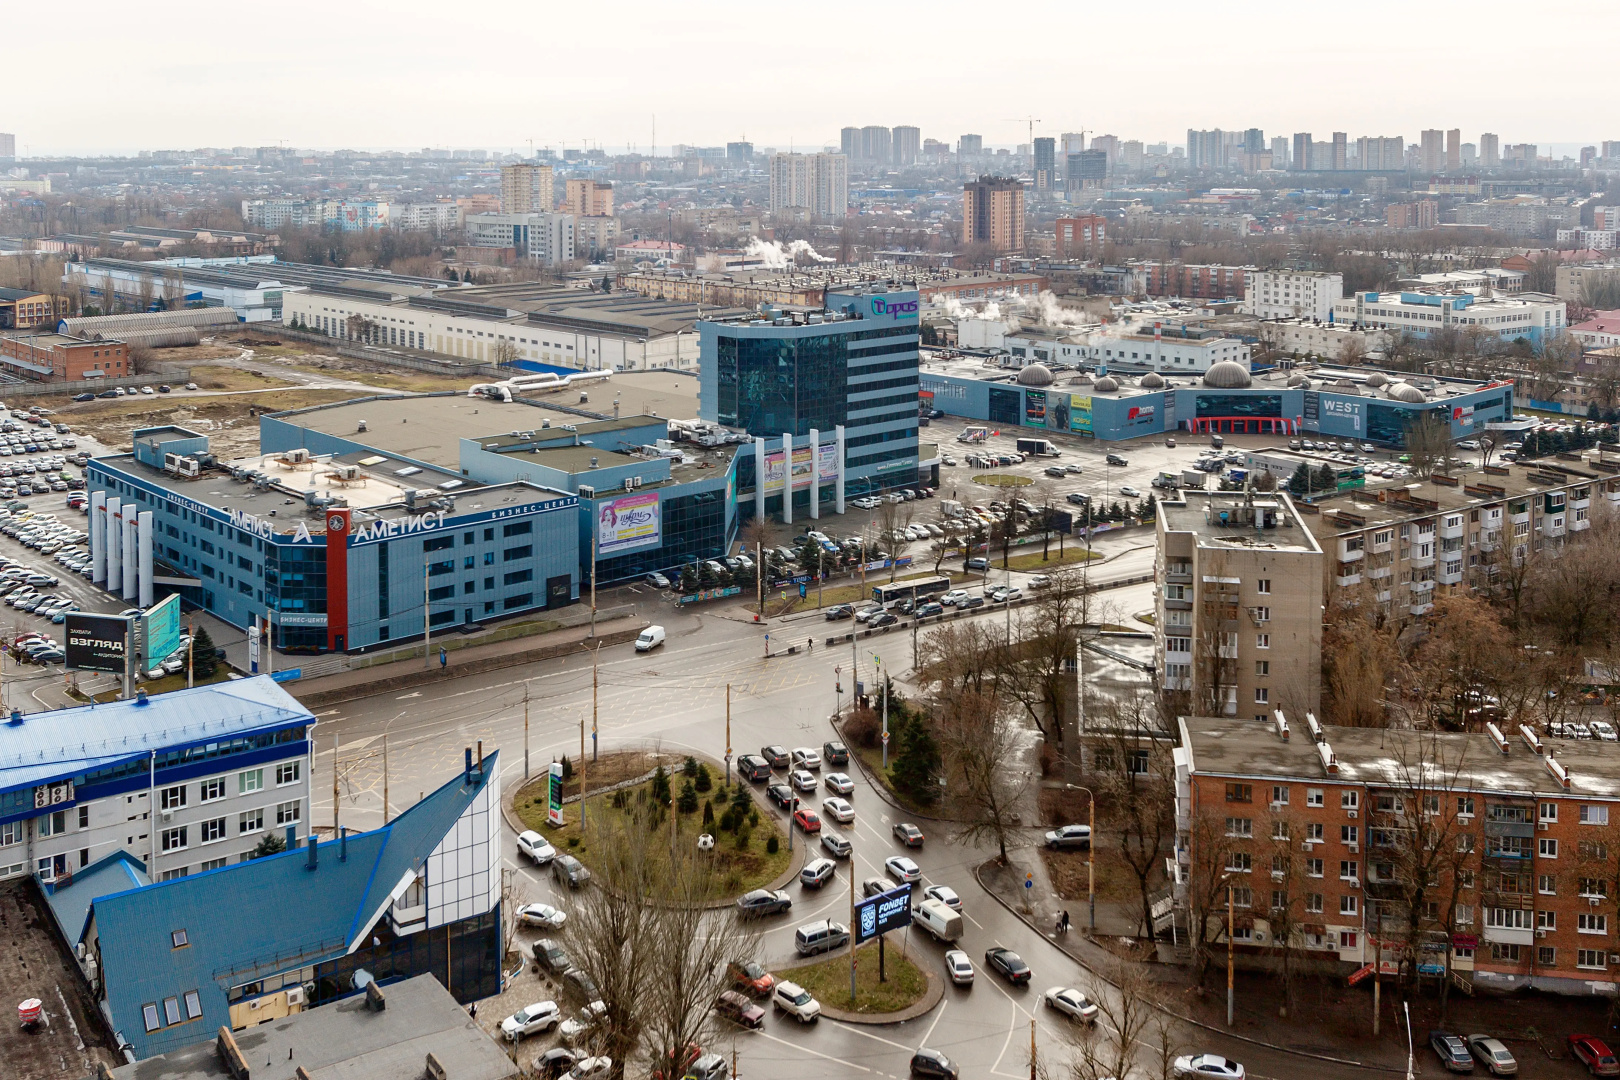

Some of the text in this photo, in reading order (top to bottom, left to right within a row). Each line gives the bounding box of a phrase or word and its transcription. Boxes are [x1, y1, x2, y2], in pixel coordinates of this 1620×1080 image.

[1324, 400, 1360, 414] WEST
[491, 497, 578, 519] БИЗНЕС-ЦЕНТР
[229, 508, 274, 540] АМЕТИСТ
[354, 510, 448, 543] АМЕТИСТ
[70, 637, 123, 651] ВЗГЛЯД
[878, 895, 909, 914] FONBET
